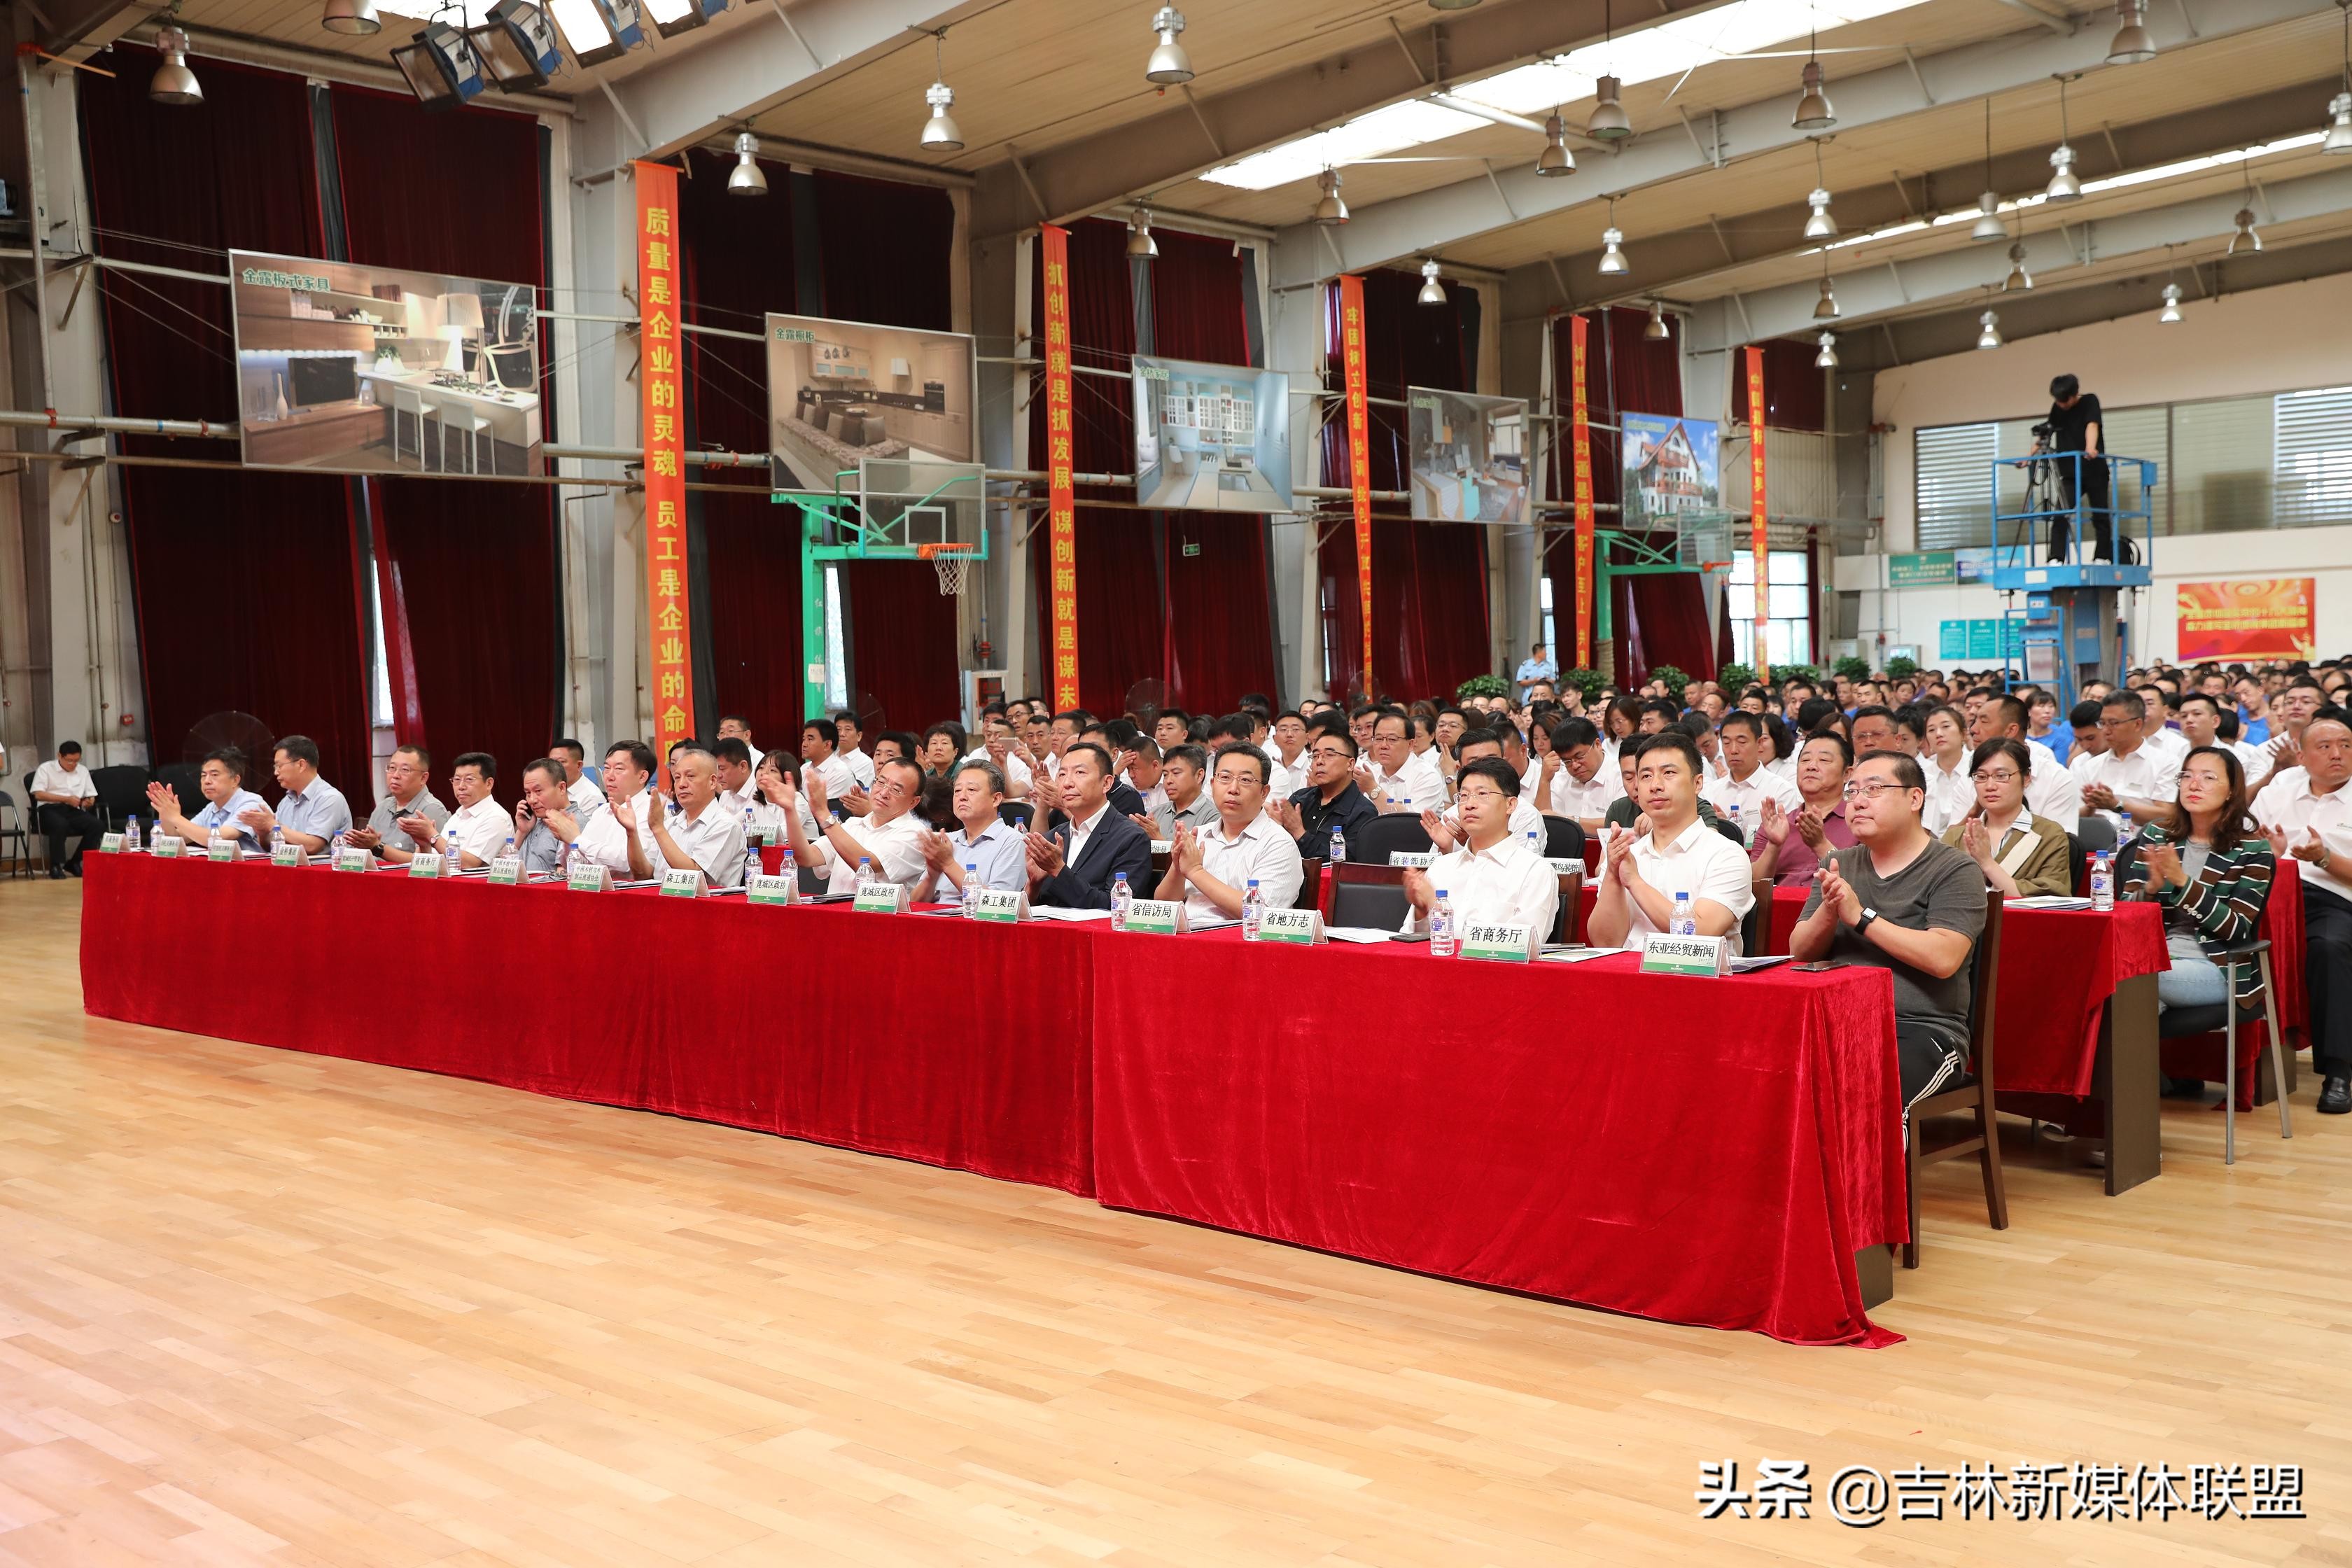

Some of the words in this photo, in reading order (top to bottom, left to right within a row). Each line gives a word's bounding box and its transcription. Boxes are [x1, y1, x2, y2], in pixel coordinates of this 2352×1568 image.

[243, 268, 330, 292] 金露板式家具
[645, 207, 678, 477] 质量是企业的灵魂
[1048, 261, 1070, 490] 抓创新就是抓发展
[414, 857, 437, 868] 省商务厅
[665, 873, 695, 886] 森工集团
[755, 879, 786, 890] 宽城区政协
[860, 887, 895, 898] 宽城区政府
[980, 894, 1016, 908] 森工集团
[1131, 902, 1172, 918] 省信访局
[1266, 912, 1310, 928] 省地方志
[1469, 927, 1522, 944] 省商务厅
[1647, 941, 1715, 958] 东亚经贸新闻
